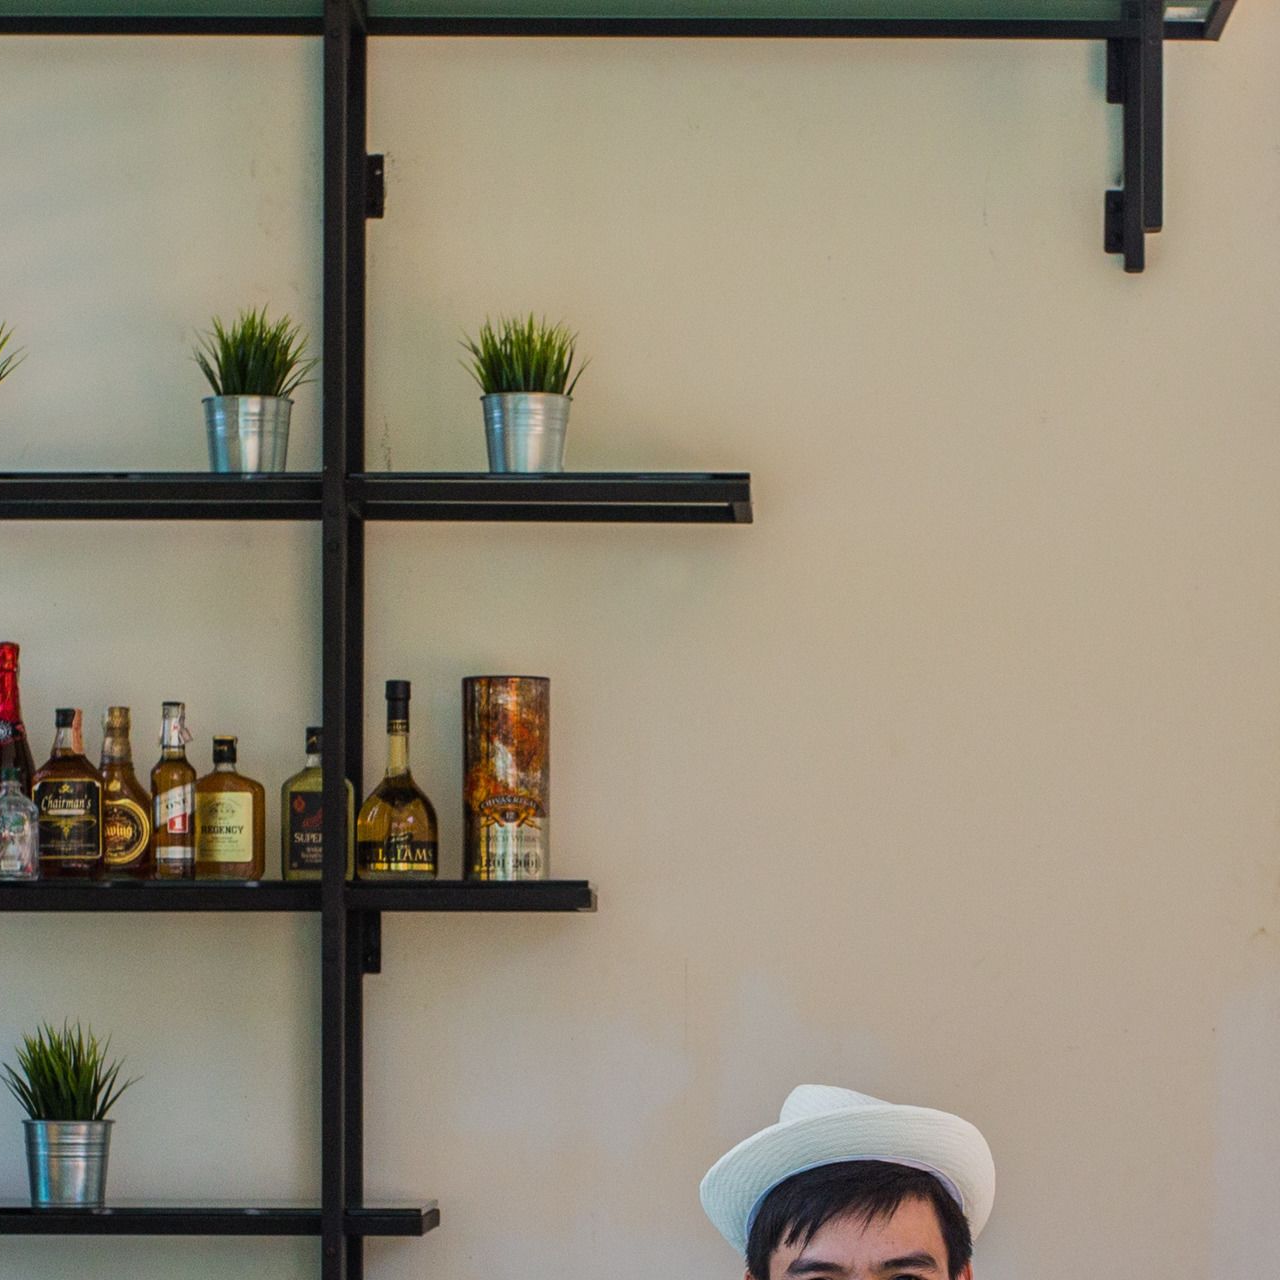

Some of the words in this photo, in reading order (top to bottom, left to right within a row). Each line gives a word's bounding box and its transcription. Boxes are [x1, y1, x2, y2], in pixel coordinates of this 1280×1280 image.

[41, 793, 92, 811] Chairman's
[480, 795, 511, 809] CHIVAS
[201, 824, 244, 835] REGENCY
